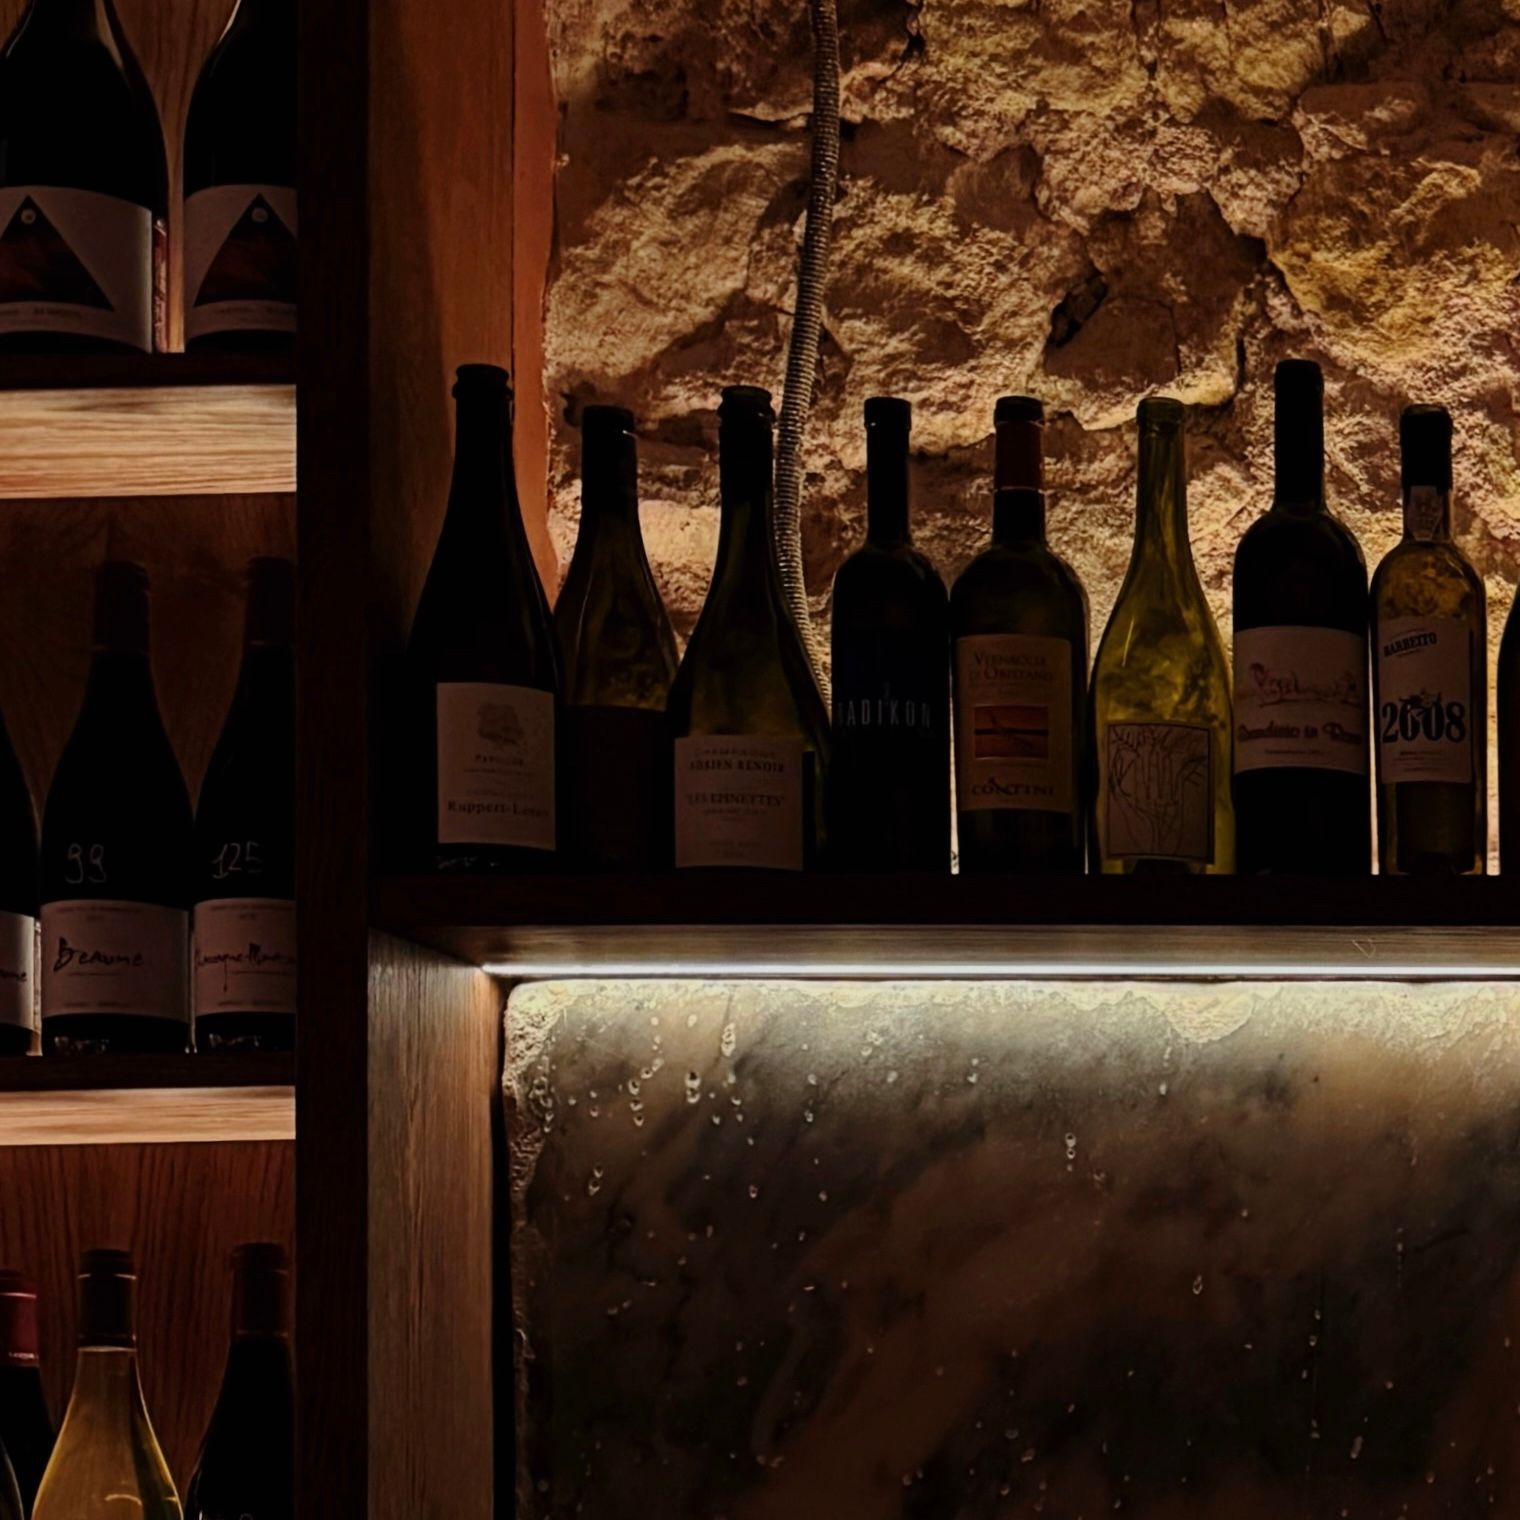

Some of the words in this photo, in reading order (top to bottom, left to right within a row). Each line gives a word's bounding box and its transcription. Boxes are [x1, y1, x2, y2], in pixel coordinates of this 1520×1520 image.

[1381, 699, 1467, 744] 2008
[971, 775, 1057, 797] CONTINI
[63, 842, 109, 884] 99
[210, 840, 264, 880] 125
